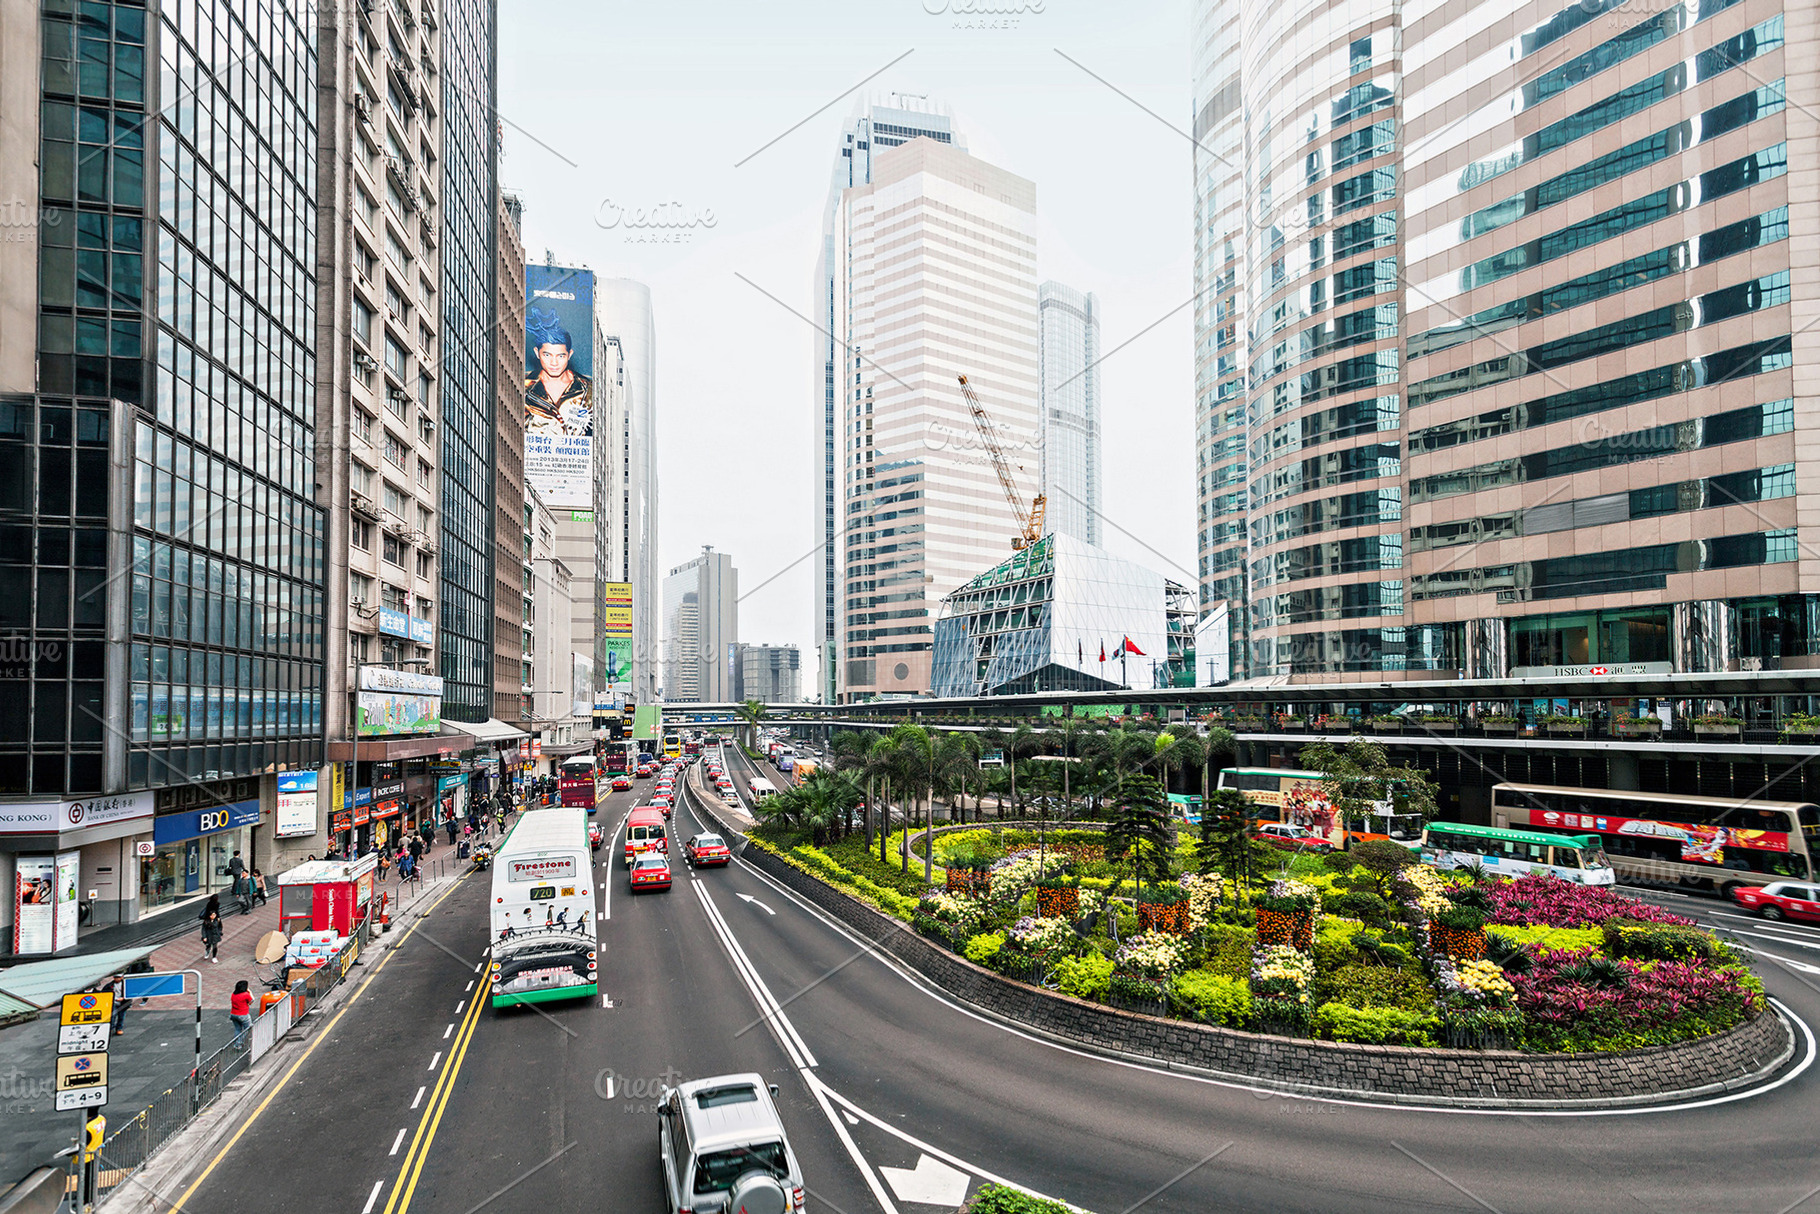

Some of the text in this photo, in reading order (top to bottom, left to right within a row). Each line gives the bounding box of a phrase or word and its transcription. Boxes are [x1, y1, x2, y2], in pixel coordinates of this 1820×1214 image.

[1554, 667, 1588, 677] HSBC
[356, 792, 370, 801] Expert
[200, 810, 229, 831] BDO
[514, 861, 571, 872] Firestone
[533, 888, 553, 899] 720
[91, 1026, 100, 1035] 7
[91, 1040, 105, 1049] 12
